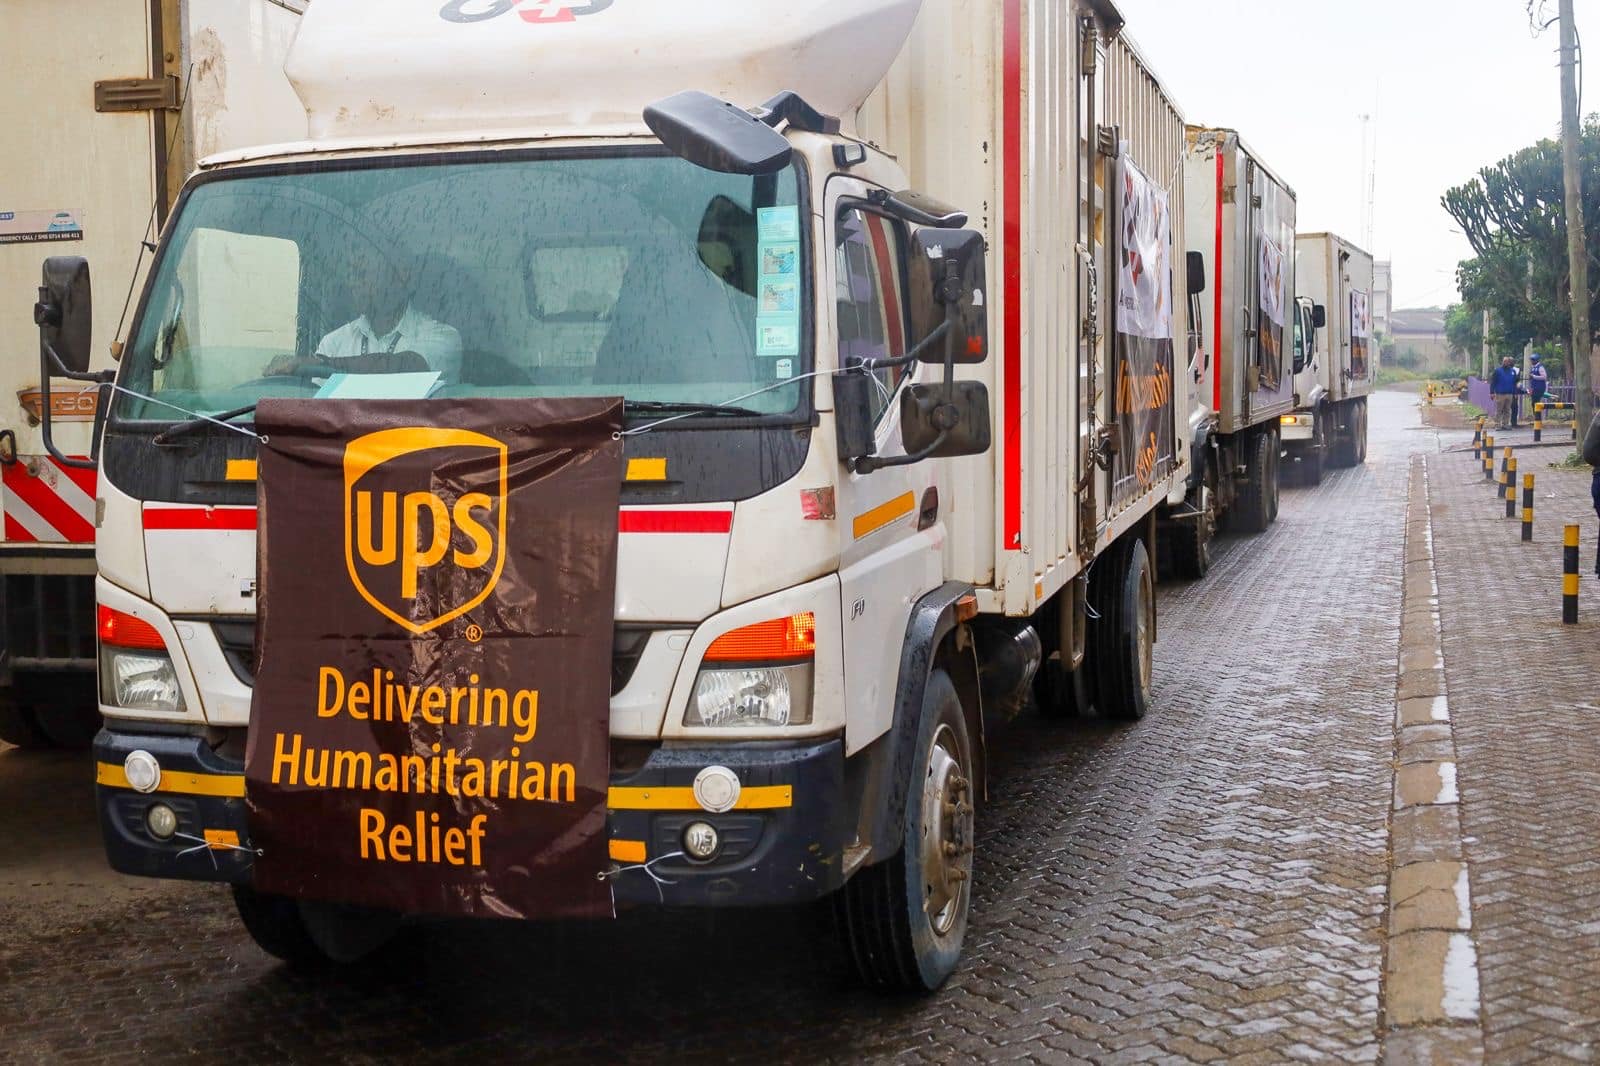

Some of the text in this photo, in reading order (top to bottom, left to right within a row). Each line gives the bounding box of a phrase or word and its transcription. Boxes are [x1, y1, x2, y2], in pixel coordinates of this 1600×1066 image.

[357, 491, 493, 599] ups
[317, 666, 539, 743] Delivering
[271, 732, 576, 802] Humanitarian
[360, 808, 488, 866] Relief
